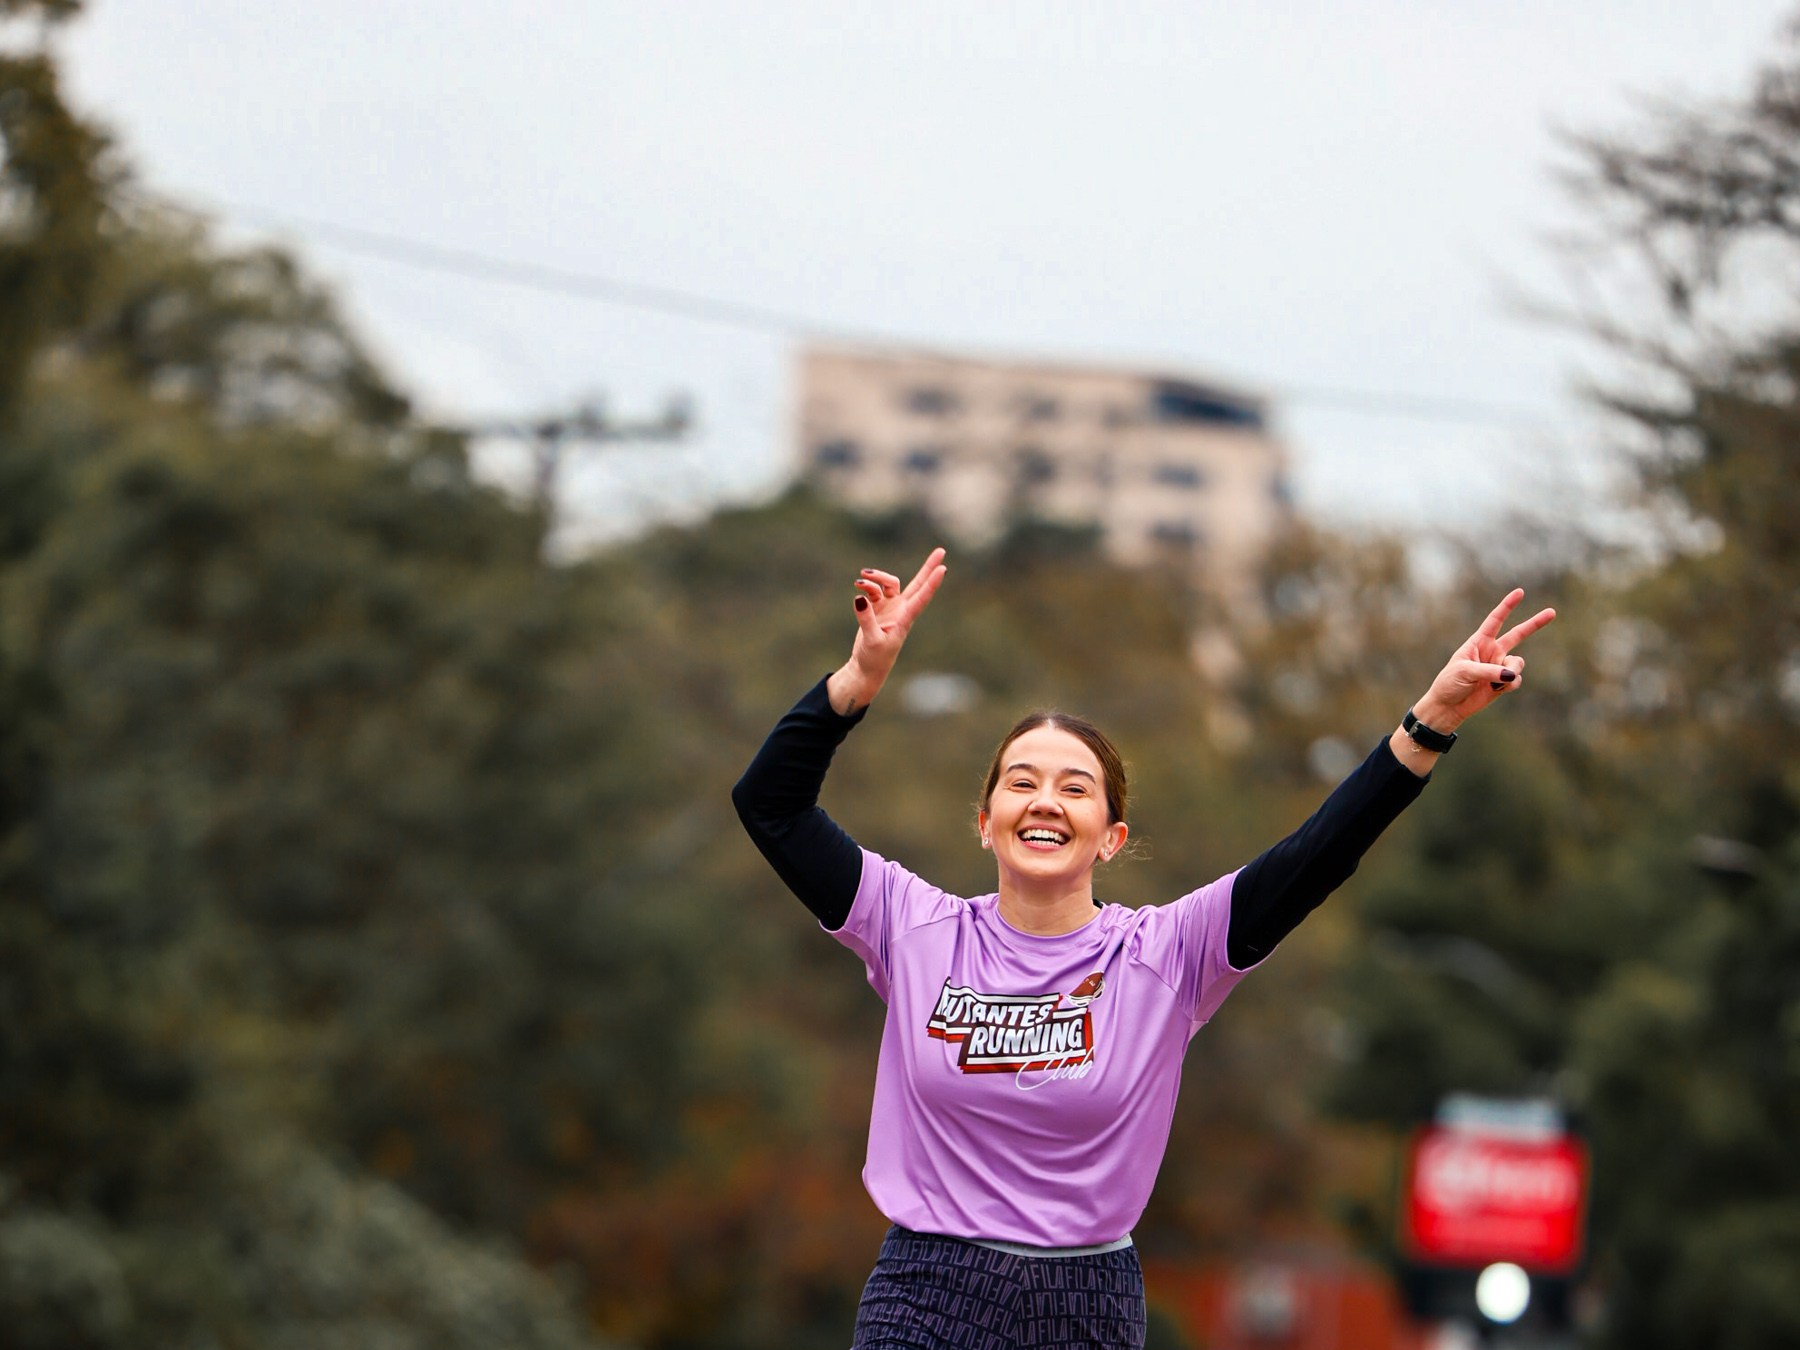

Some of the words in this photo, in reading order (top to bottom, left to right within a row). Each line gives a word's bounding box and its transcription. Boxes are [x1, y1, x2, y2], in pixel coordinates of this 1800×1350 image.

[968, 1018, 1083, 1055] RUNNING
[1016, 1047, 1094, 1090] Club
[939, 1243, 975, 1267] FILA
[974, 1248, 1014, 1276] FILA
[1030, 1264, 1064, 1289] FILA
[1065, 1266, 1096, 1290] FILA
[960, 1296, 994, 1328] FILA
[1038, 1318, 1067, 1342] FILA
